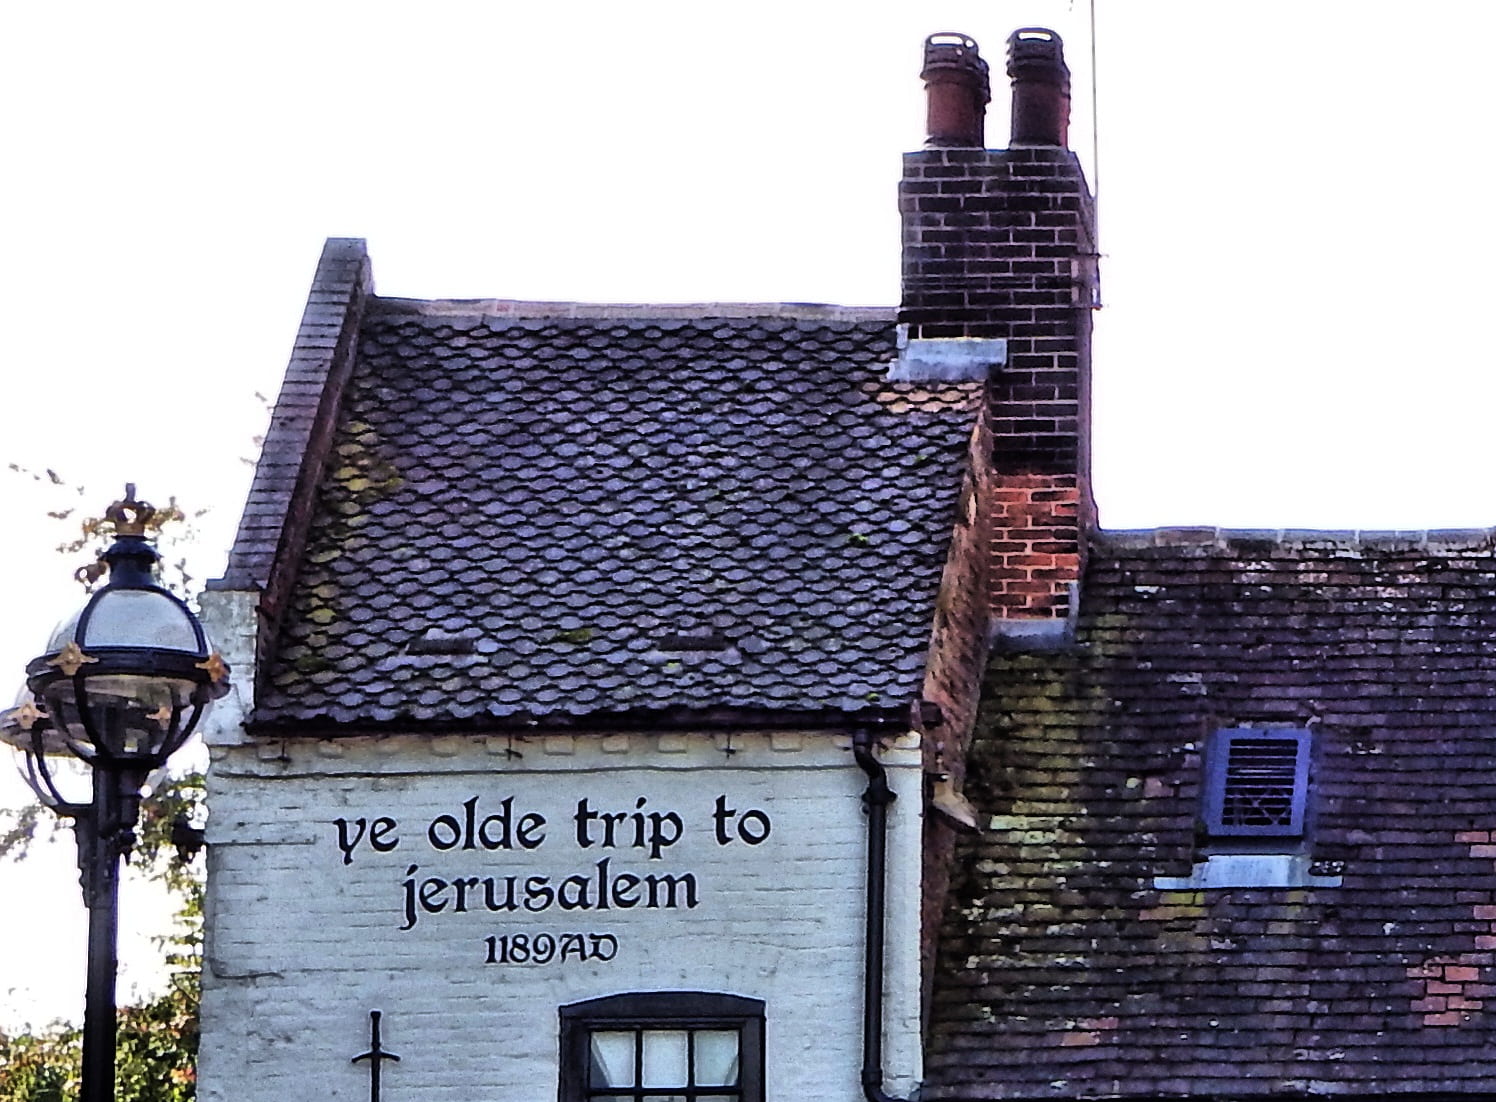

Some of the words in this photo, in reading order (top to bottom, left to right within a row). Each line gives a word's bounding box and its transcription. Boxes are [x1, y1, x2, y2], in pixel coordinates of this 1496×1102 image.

[333, 816, 400, 865] ye
[427, 796, 547, 851] olde
[573, 797, 684, 860] trip
[712, 794, 771, 846] to
[399, 858, 700, 931] jerusalem
